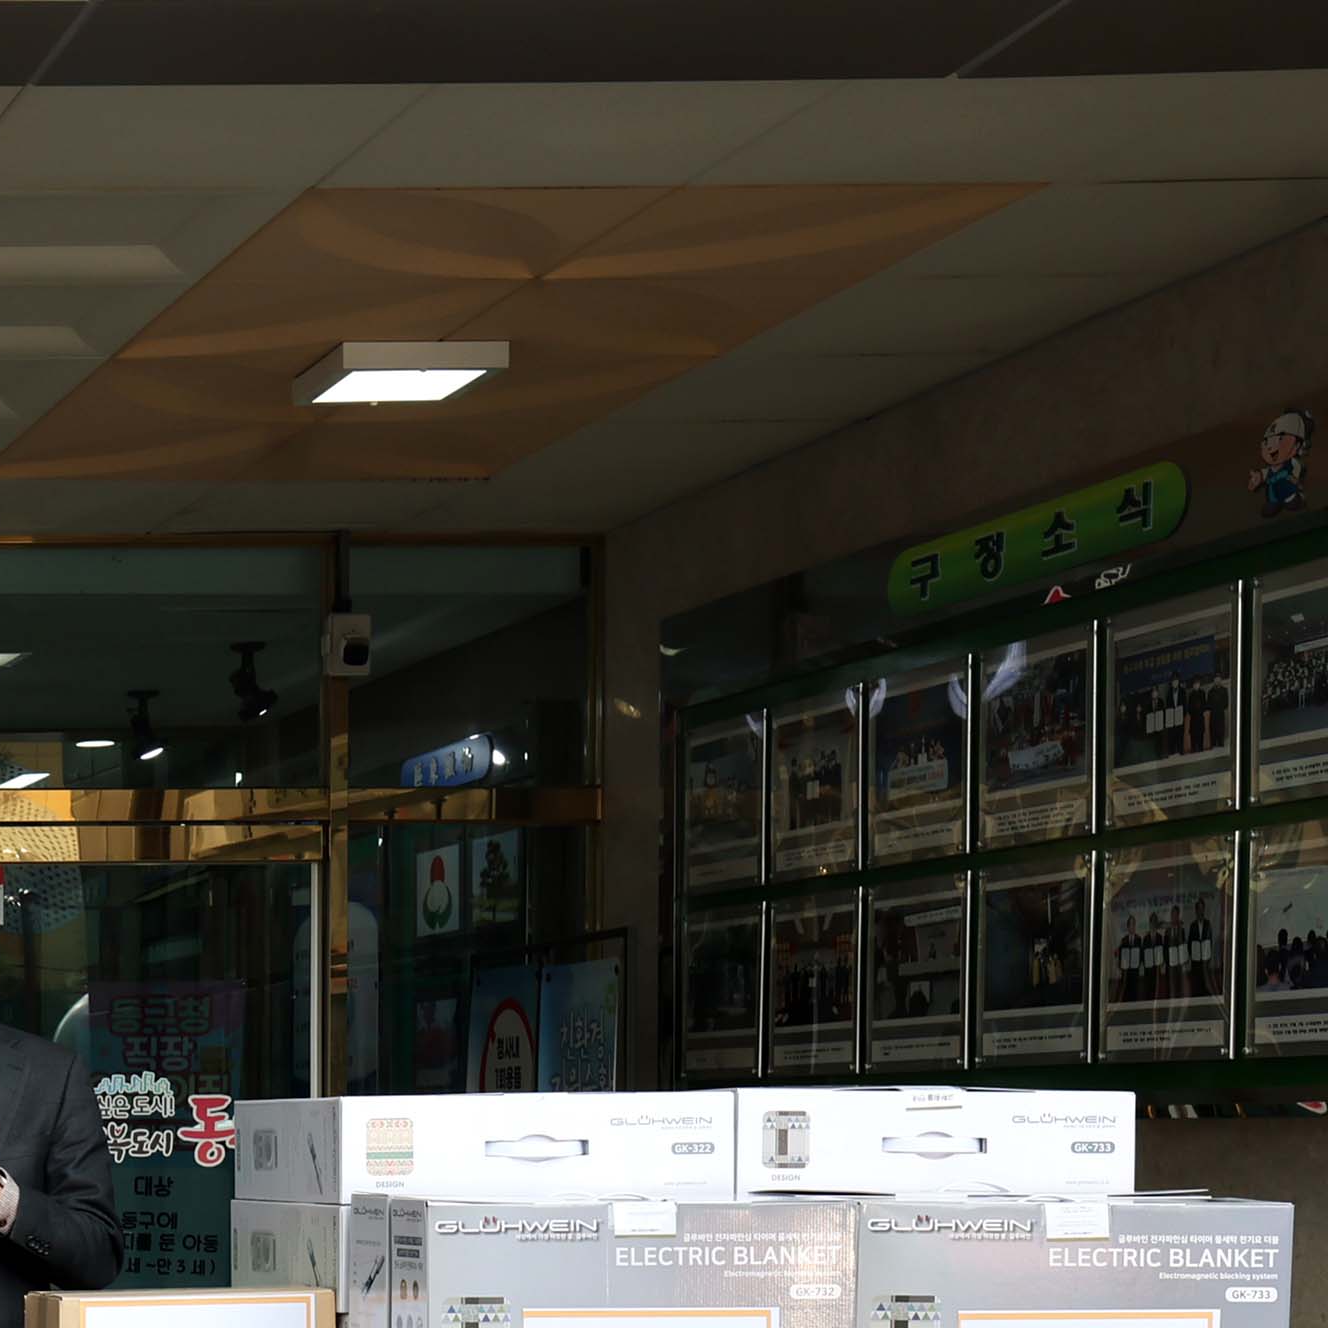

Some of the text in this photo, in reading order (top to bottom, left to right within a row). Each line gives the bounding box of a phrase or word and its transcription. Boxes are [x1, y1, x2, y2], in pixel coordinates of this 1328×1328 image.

[131, 1095, 176, 1119] 도시!
[1073, 1141, 1113, 1154] GK-733
[771, 1173, 801, 1181] DESIGN
[133, 1176, 174, 1197] 대상
[867, 1214, 1034, 1234] GLÜHWEIN
[1047, 1246, 1280, 1270] ELECTRIC BLANKET
[1158, 1271, 1279, 1282] Electromagnetic blocking system
[1230, 1288, 1272, 1301] GK-733
